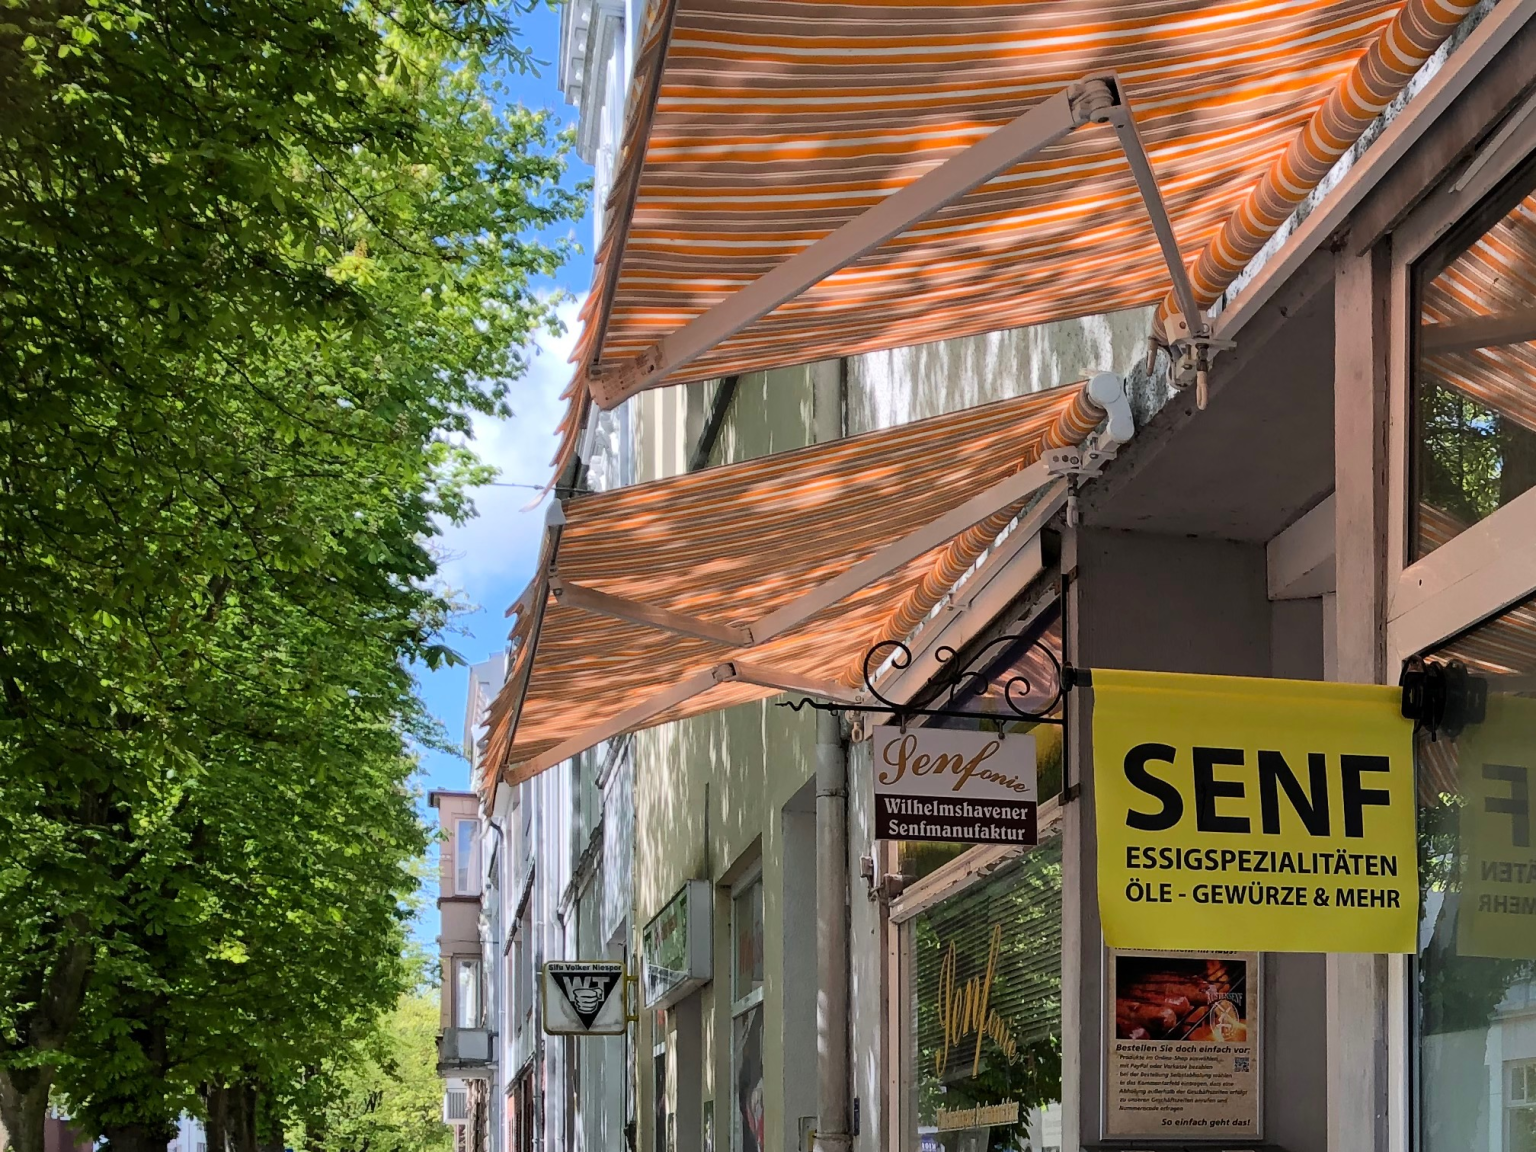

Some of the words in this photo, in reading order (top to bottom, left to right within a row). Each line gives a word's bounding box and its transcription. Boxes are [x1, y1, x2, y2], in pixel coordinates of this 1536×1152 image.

[878, 734, 1030, 793] Senfonie
[1123, 742, 1391, 838] SENF
[884, 798, 1028, 820] Wilhelmshavener
[888, 819, 1026, 841] Senfmanufaktur
[1126, 846, 1398, 877] ESSIGSPEZIALITÄTEN
[1125, 878, 1173, 903] ÖLE
[1192, 881, 1308, 906] GEWÜRZE
[1313, 888, 1330, 907] &
[1335, 888, 1400, 909] MEHR
[1116, 1044, 1157, 1053] Bestellen
[1159, 1045, 1173, 1053] Sie
[1175, 1045, 1198, 1053] doch
[1199, 1045, 1231, 1054] einfach
[1161, 1118, 1173, 1126] So
[1175, 1118, 1207, 1127] einfach
[1209, 1119, 1230, 1128] geht
[1232, 1119, 1251, 1127] das!
